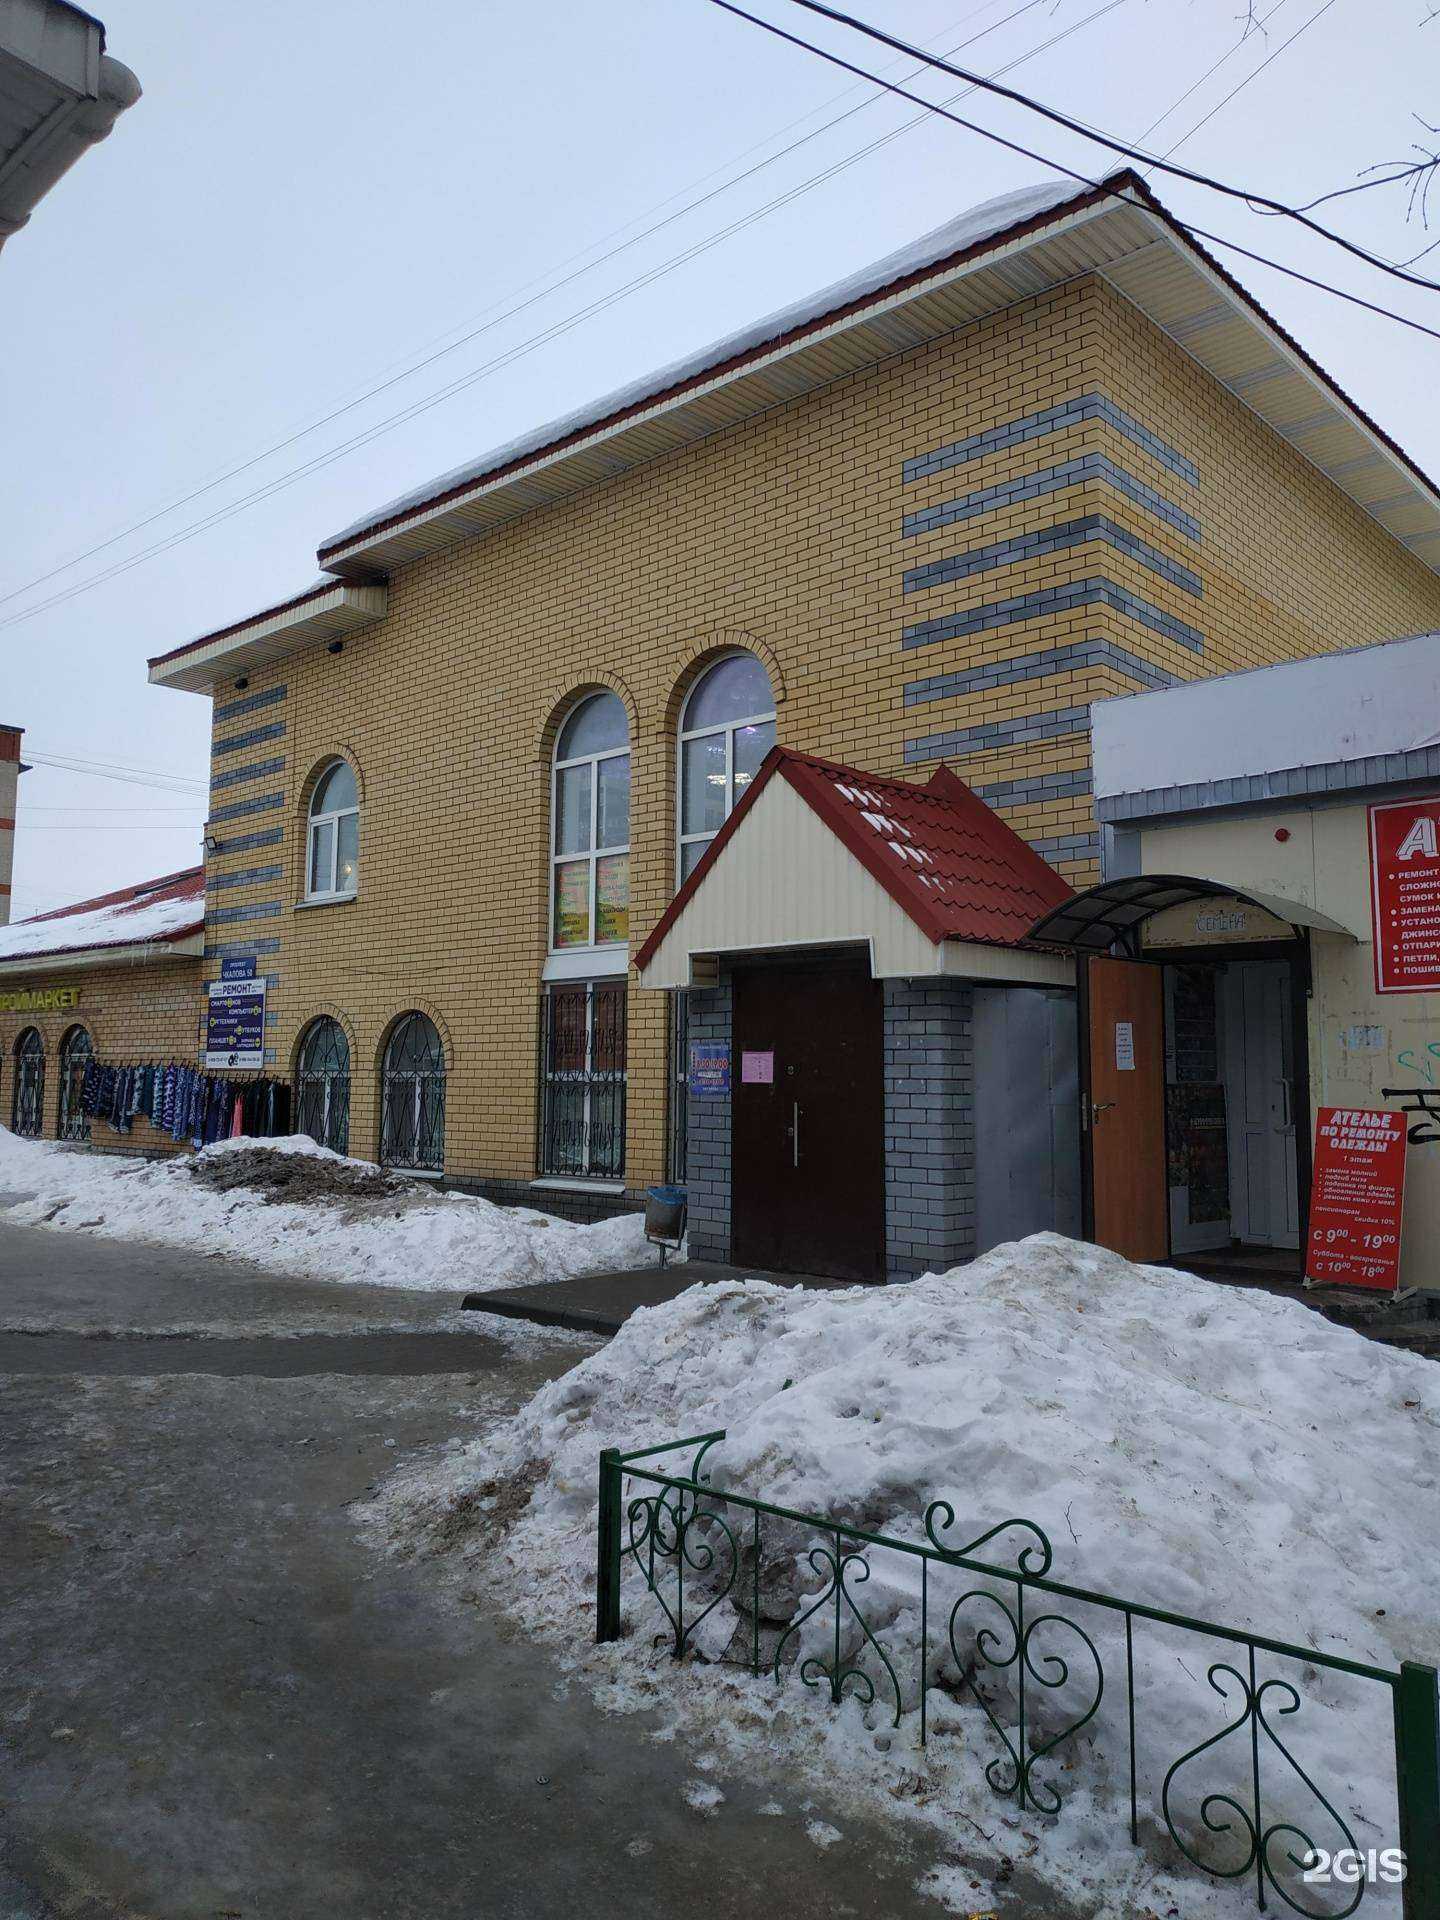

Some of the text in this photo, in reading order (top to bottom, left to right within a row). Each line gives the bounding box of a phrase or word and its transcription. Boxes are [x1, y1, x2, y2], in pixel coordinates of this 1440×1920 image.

[1396, 816, 1440, 860] А
[1398, 868, 1440, 880] РЕМОНТ
[1399, 893, 1434, 903] СУМОК
[1401, 929, 1440, 940] ДЖИНС
[222, 983, 253, 995] РЕМОНТ
[1330, 1110, 1392, 1128] АТЕЛЬЕ
[1320, 1125, 1401, 1142] ПО РЕМОНТУ
[1330, 1138, 1388, 1152] ОДЕЖДЫ
[1380, 1218, 1396, 1226] 10%
[1312, 1249, 1344, 1259] Суббота
